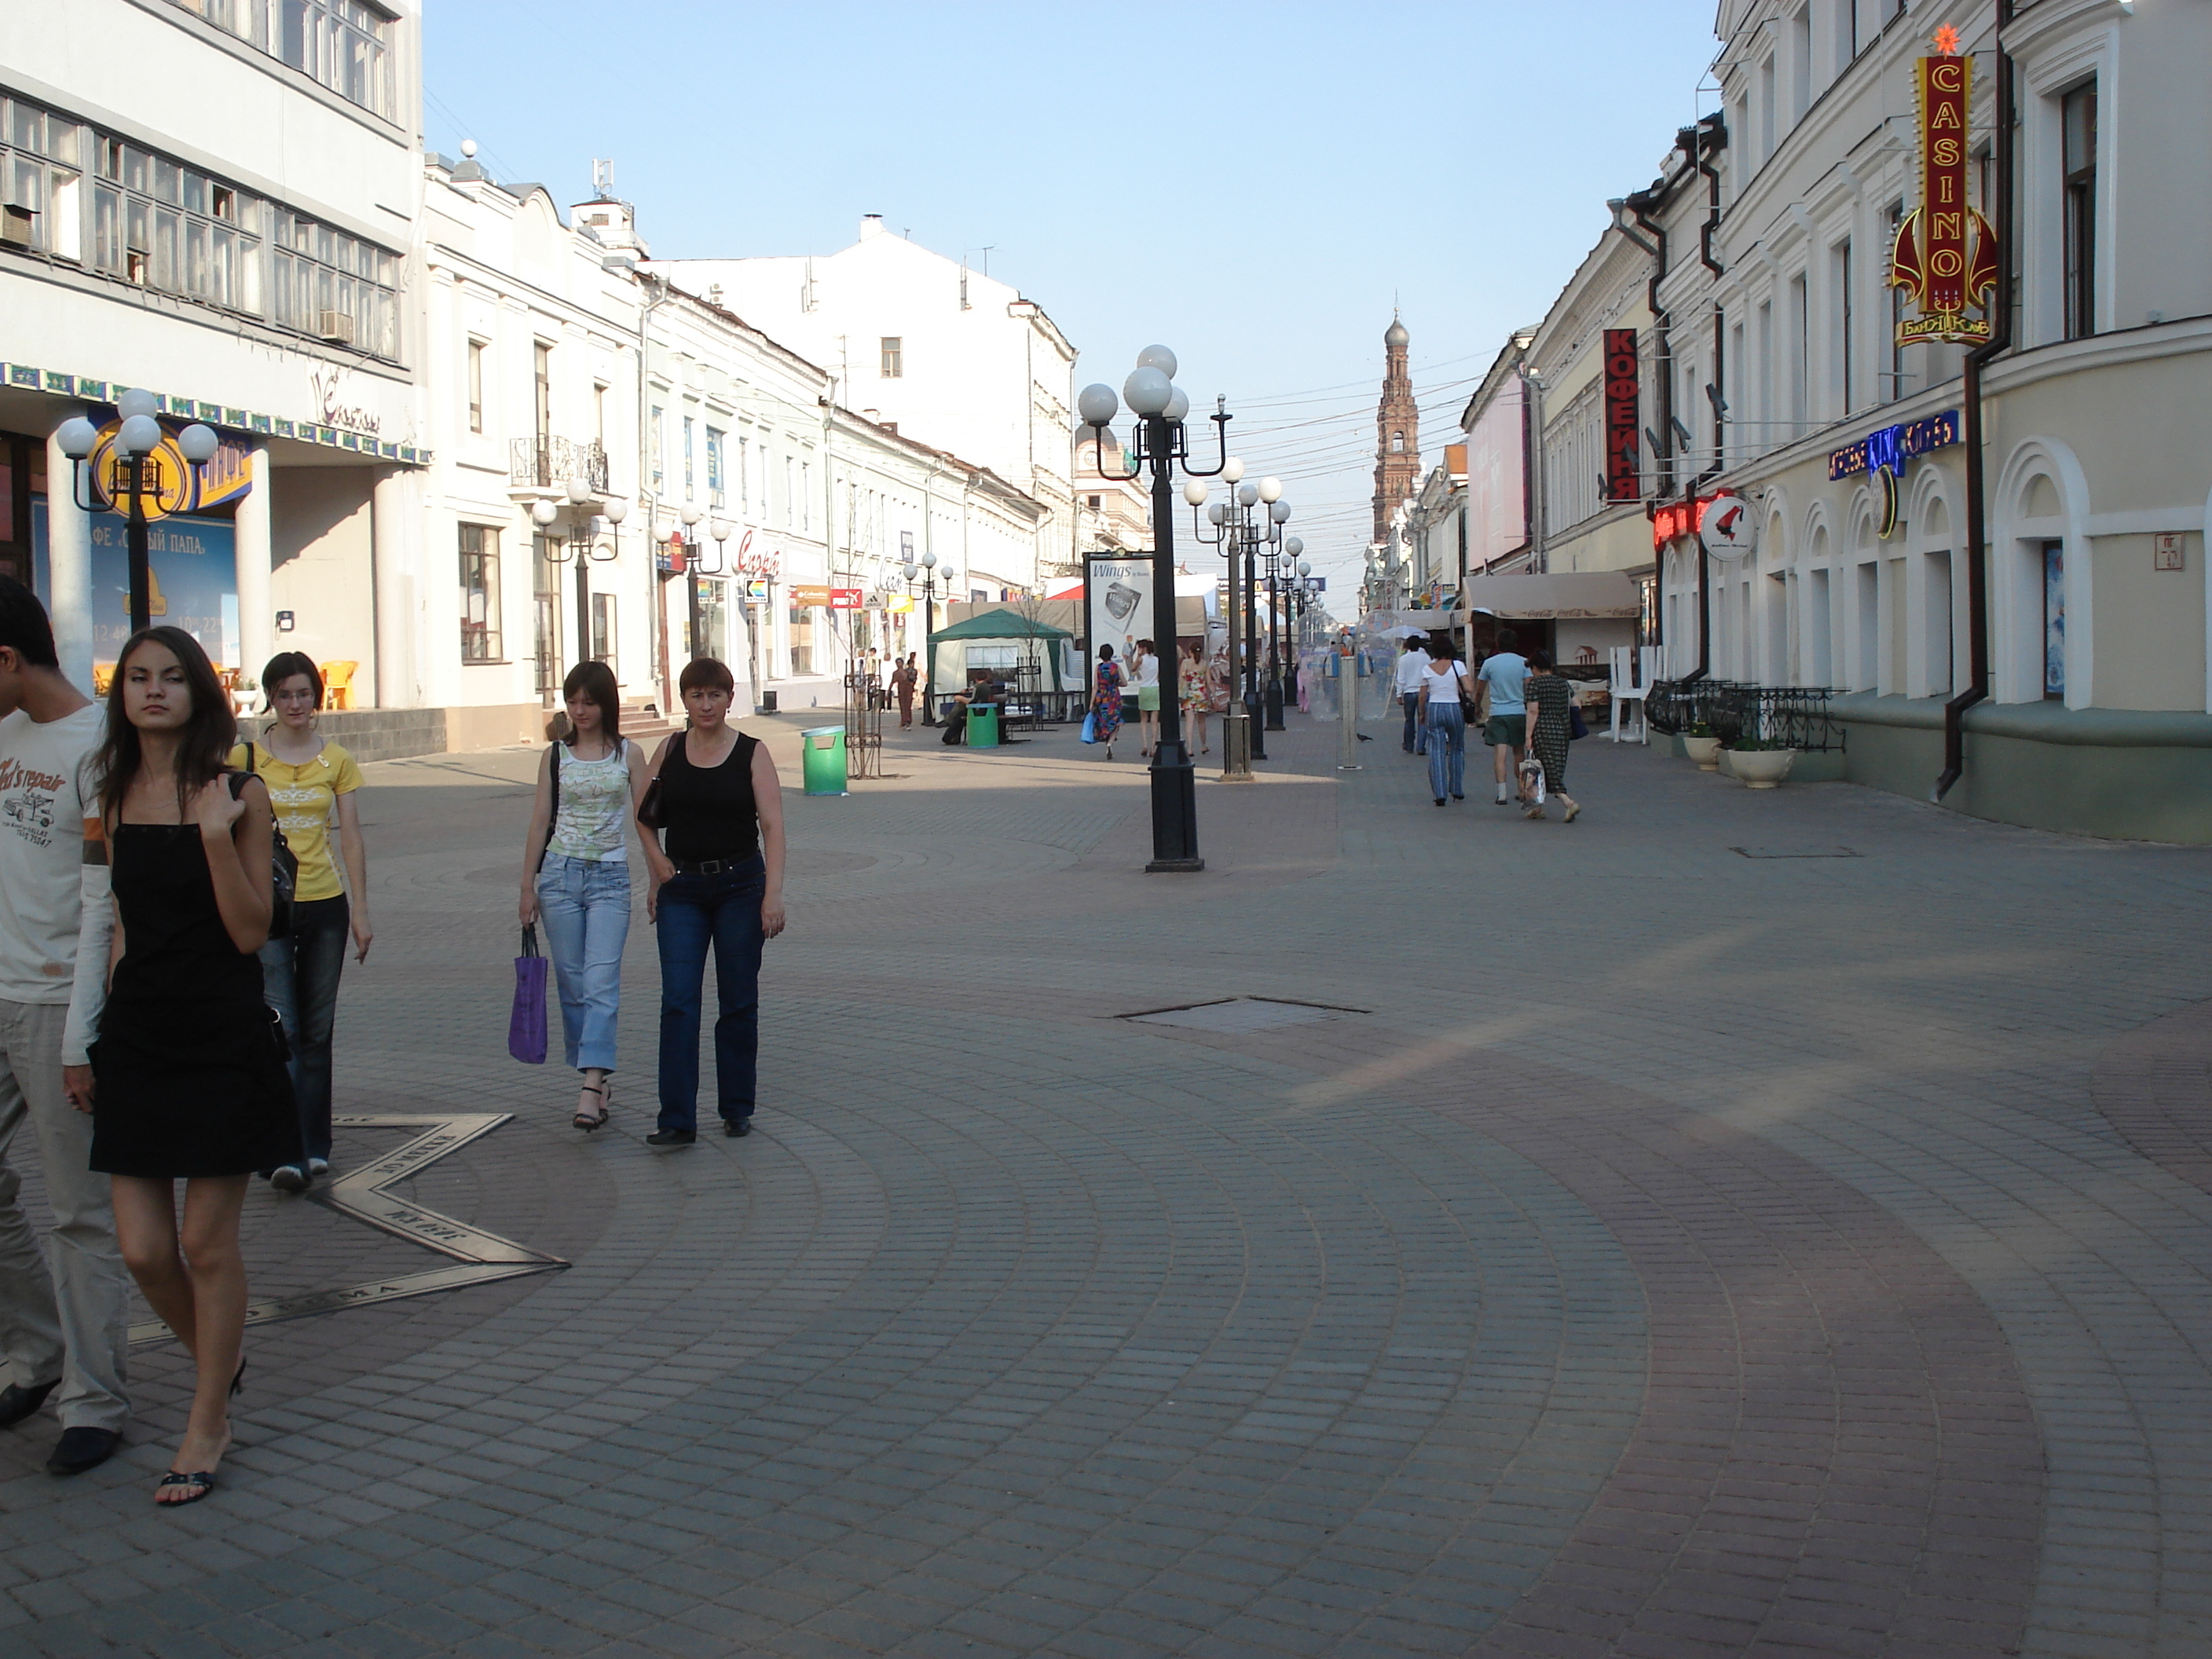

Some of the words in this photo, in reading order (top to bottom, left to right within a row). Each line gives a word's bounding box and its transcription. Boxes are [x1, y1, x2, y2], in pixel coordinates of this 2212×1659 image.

[1931, 64, 1963, 277] CASINO
[1606, 330, 1639, 500] КОФЕЙНЯ
[1093, 564, 1132, 580] Wings
[21, 769, 66, 793] repair
